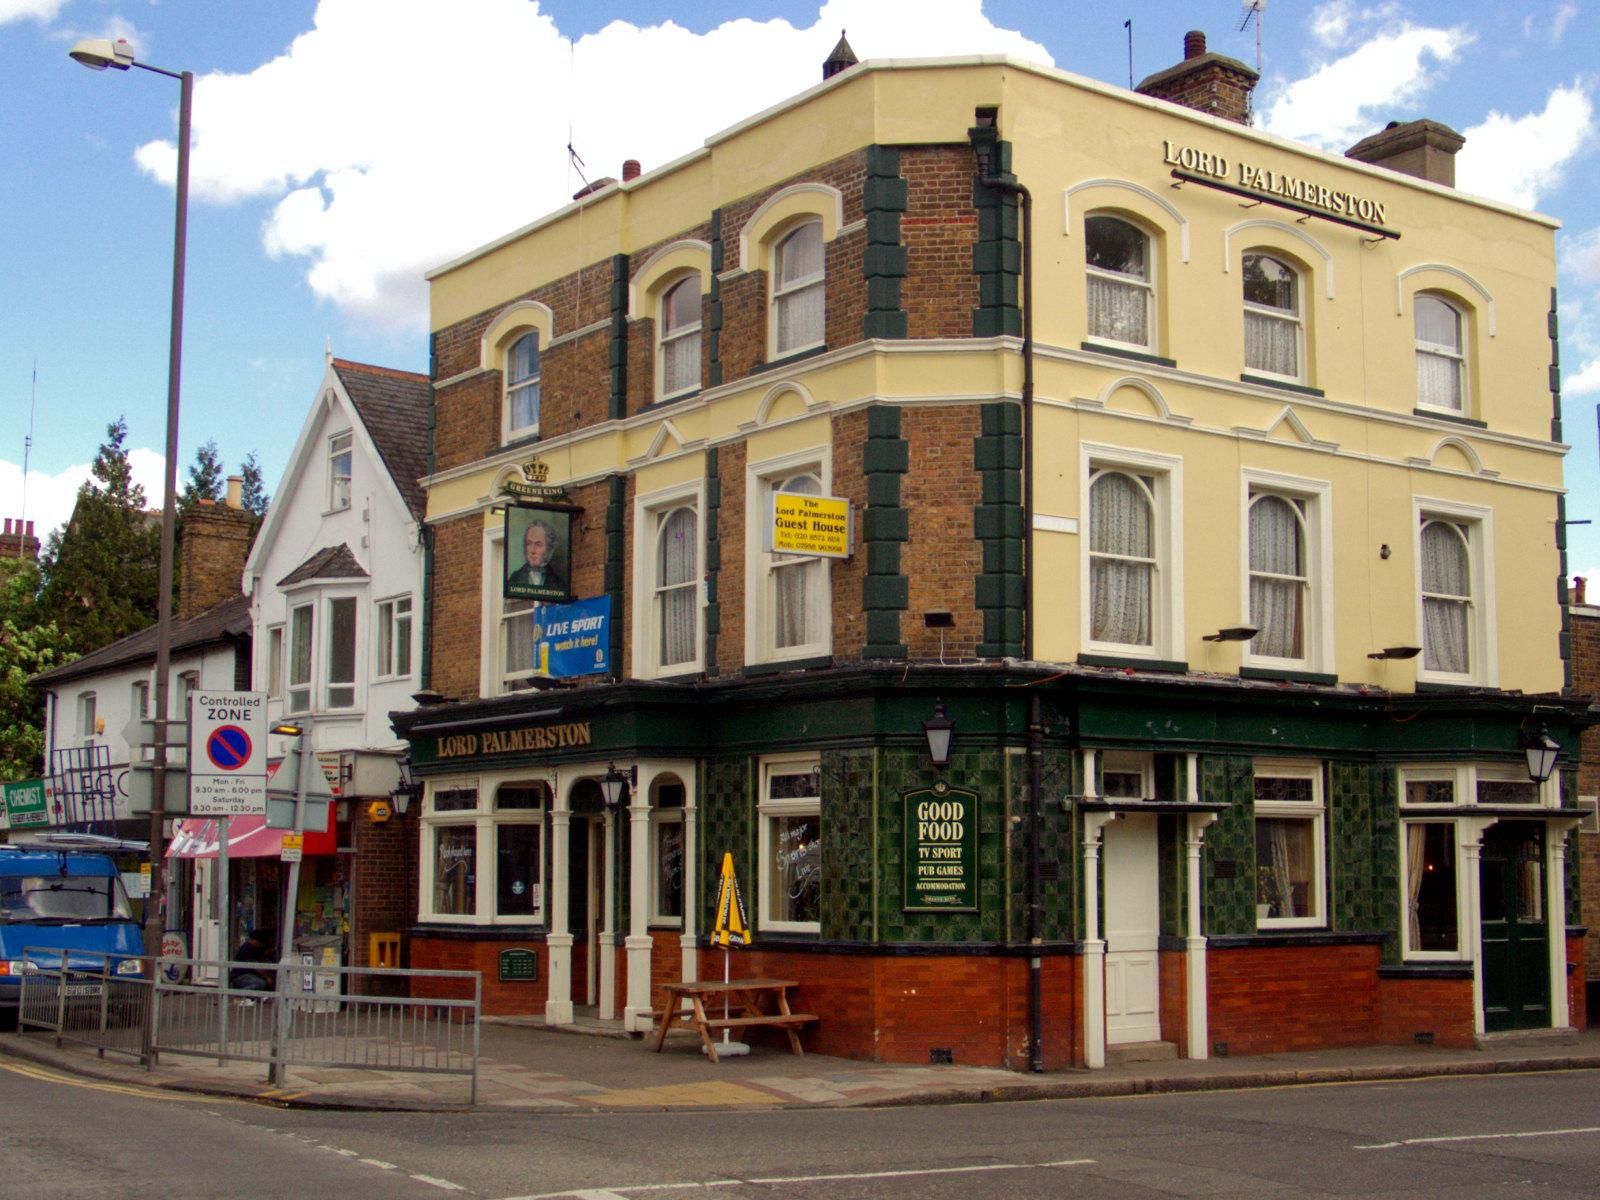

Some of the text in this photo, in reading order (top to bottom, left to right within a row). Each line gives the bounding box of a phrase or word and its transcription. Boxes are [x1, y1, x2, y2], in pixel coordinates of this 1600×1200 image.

[1165, 140, 1386, 224] LORD PALMERSTON
[510, 481, 563, 496] GREENE KING
[804, 500, 819, 508] The
[776, 507, 846, 521] Lord Palmerston
[775, 517, 846, 534] Guest House
[794, 532, 808, 540] 020
[528, 587, 565, 597] PALMERSTON
[546, 615, 605, 637] LIVE SPORT
[555, 634, 598, 651] watch it here!
[199, 695, 260, 707] Controlled
[208, 708, 252, 721] ZONE
[436, 722, 591, 758] LORD PALMERSTON
[9, 786, 41, 807] CHEMIST
[917, 802, 964, 821] GOOD
[918, 822, 964, 841] FOOD
[918, 847, 962, 858] TV SPORT
[918, 866, 964, 875] PUB GAMES
[915, 882, 966, 891] ACCOMMODATION
